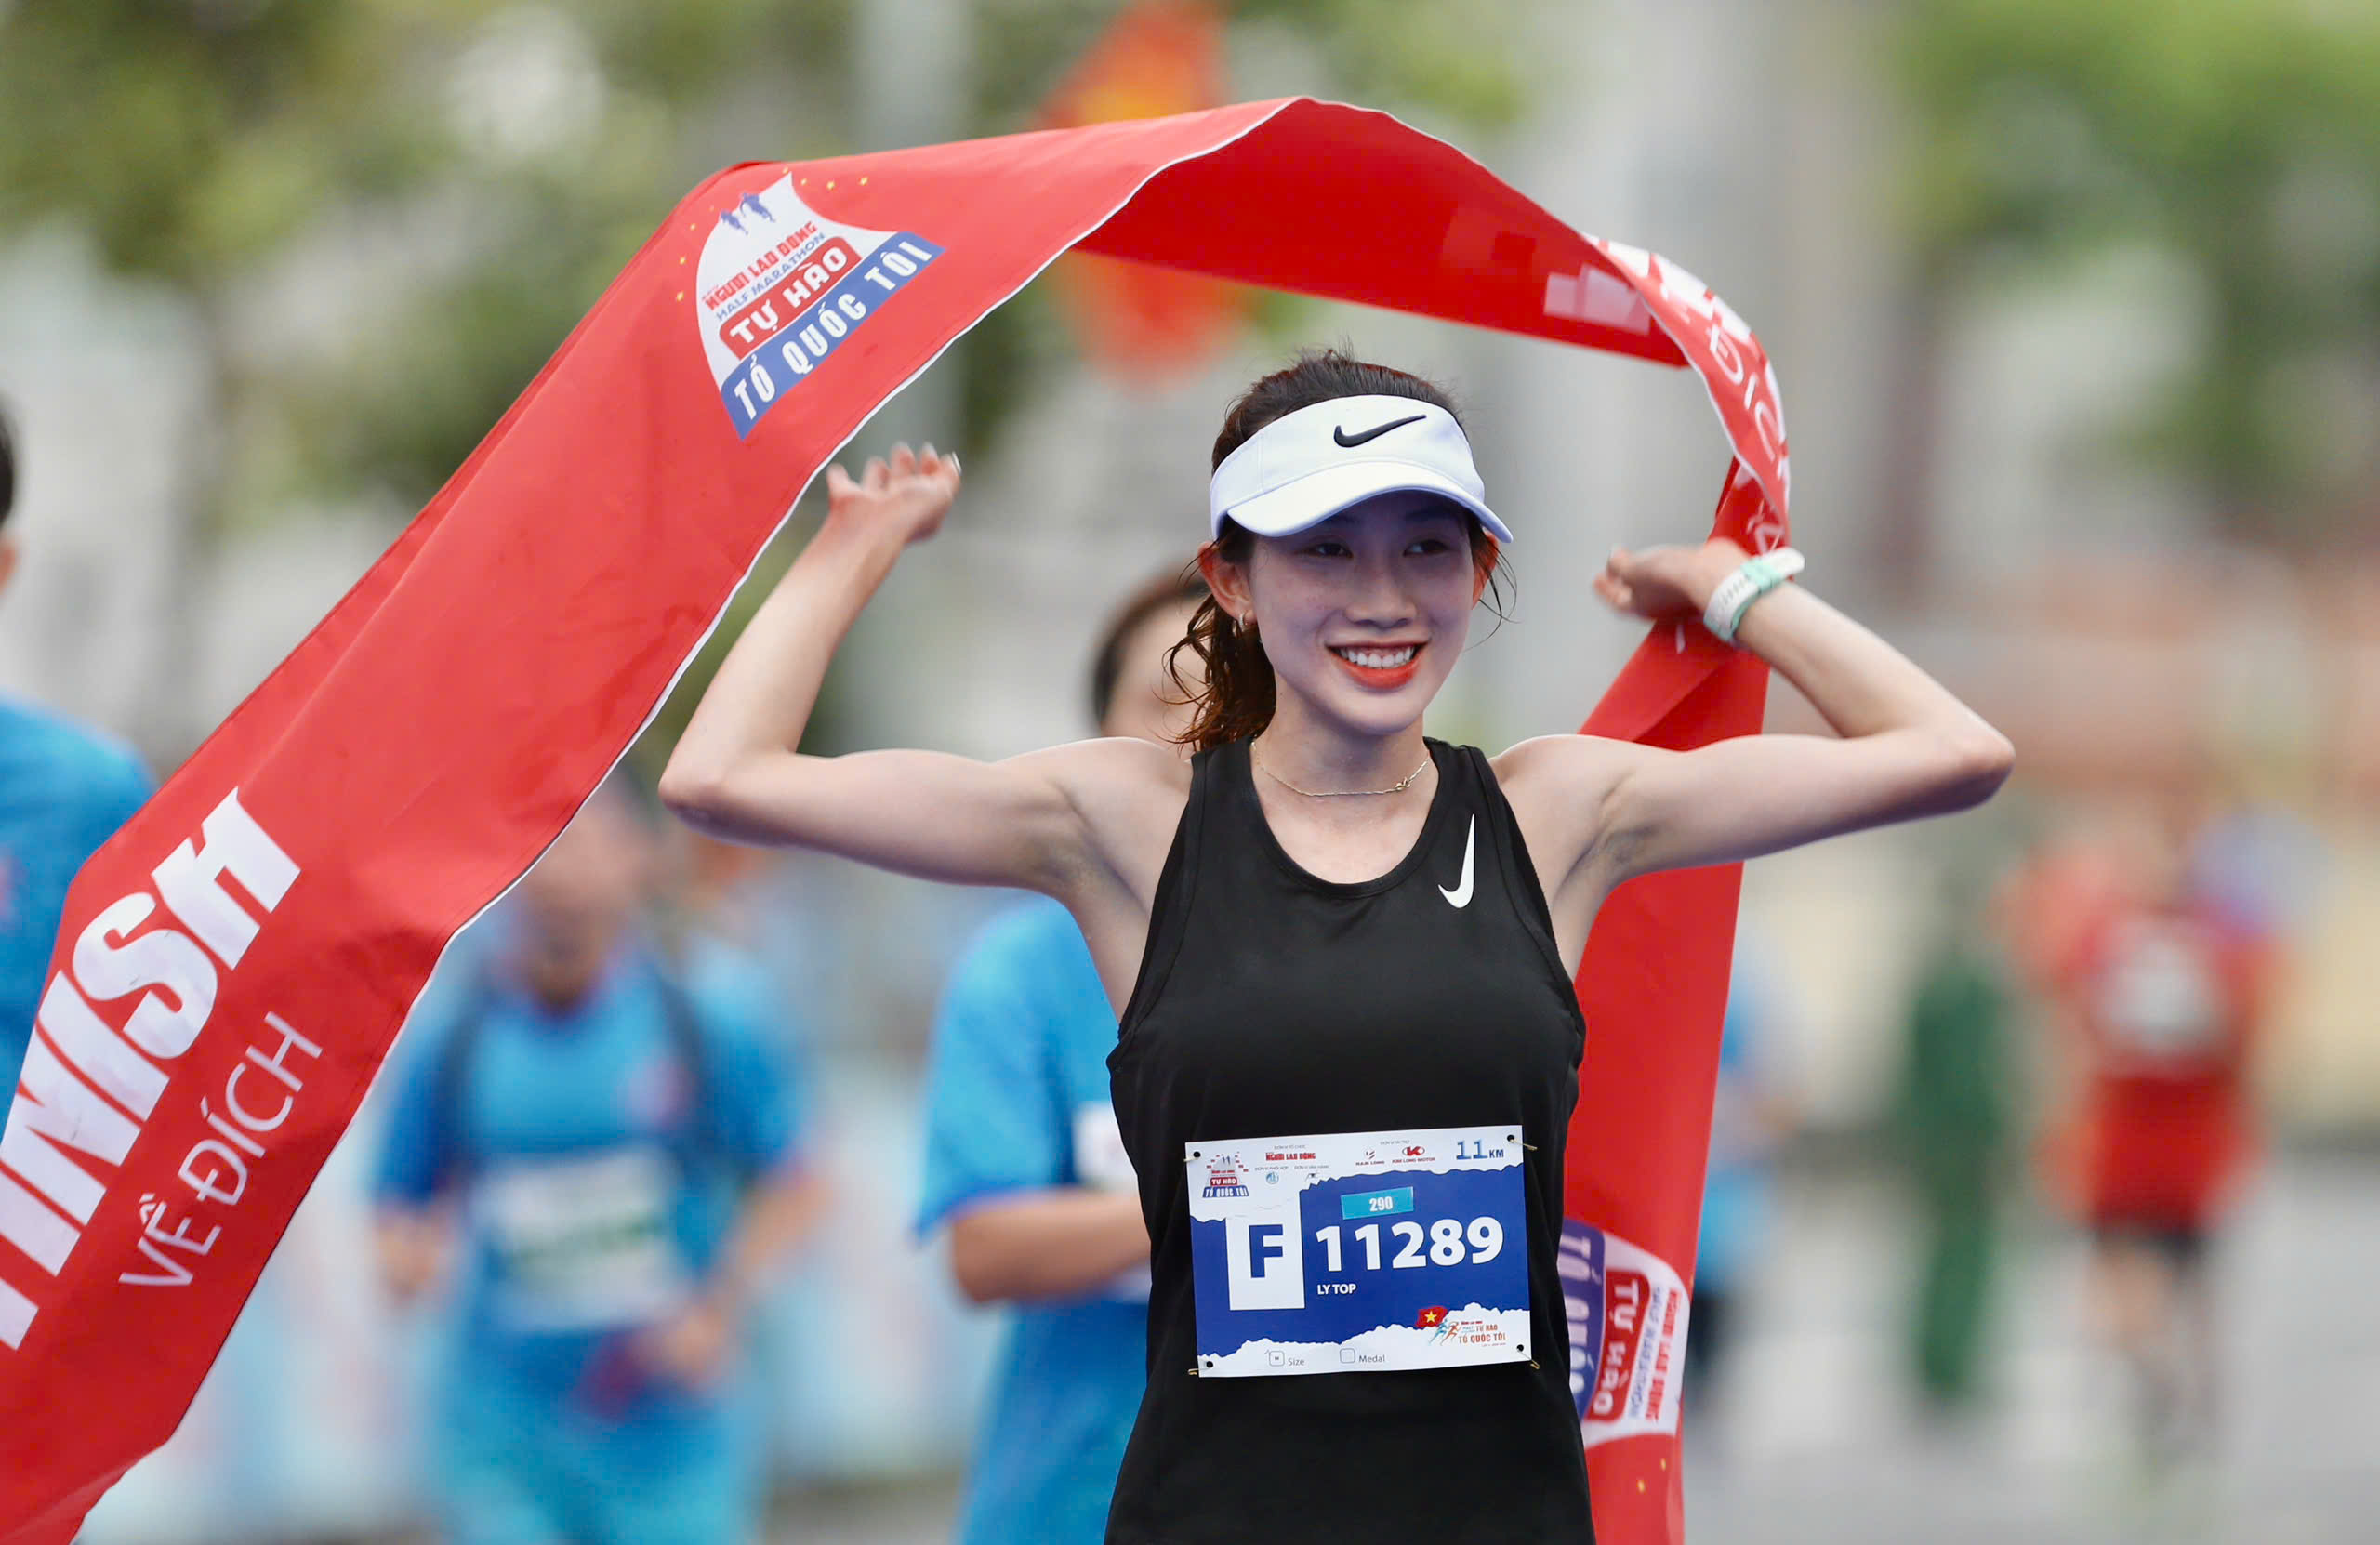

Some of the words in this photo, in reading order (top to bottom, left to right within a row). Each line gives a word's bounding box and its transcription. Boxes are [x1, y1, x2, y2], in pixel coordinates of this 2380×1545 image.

[716, 292, 748, 321] HALF
[750, 231, 825, 296] MARATHON
[730, 299, 779, 344] TỰ
[782, 246, 847, 308] HÀO
[734, 353, 776, 420] TỔ
[781, 292, 866, 375] QUỐC
[864, 240, 932, 291] TÔI
[0, 786, 301, 1351] INISH
[118, 1193, 221, 1287] VỀ
[177, 1011, 323, 1206] ĐÍCH
[1456, 1139, 1488, 1160] 11
[1488, 1148, 1504, 1159] KM
[1368, 1195, 1394, 1212] 290
[1249, 1224, 1284, 1278] F
[1316, 1216, 1504, 1272] 11289
[1316, 1284, 1331, 1295] LY
[1332, 1283, 1357, 1294] TOP
[1608, 1278, 1639, 1334] TỰ
[1288, 1357, 1305, 1366] Size
[1358, 1354, 1385, 1363] Medal
[1593, 1340, 1630, 1415] HÀO
